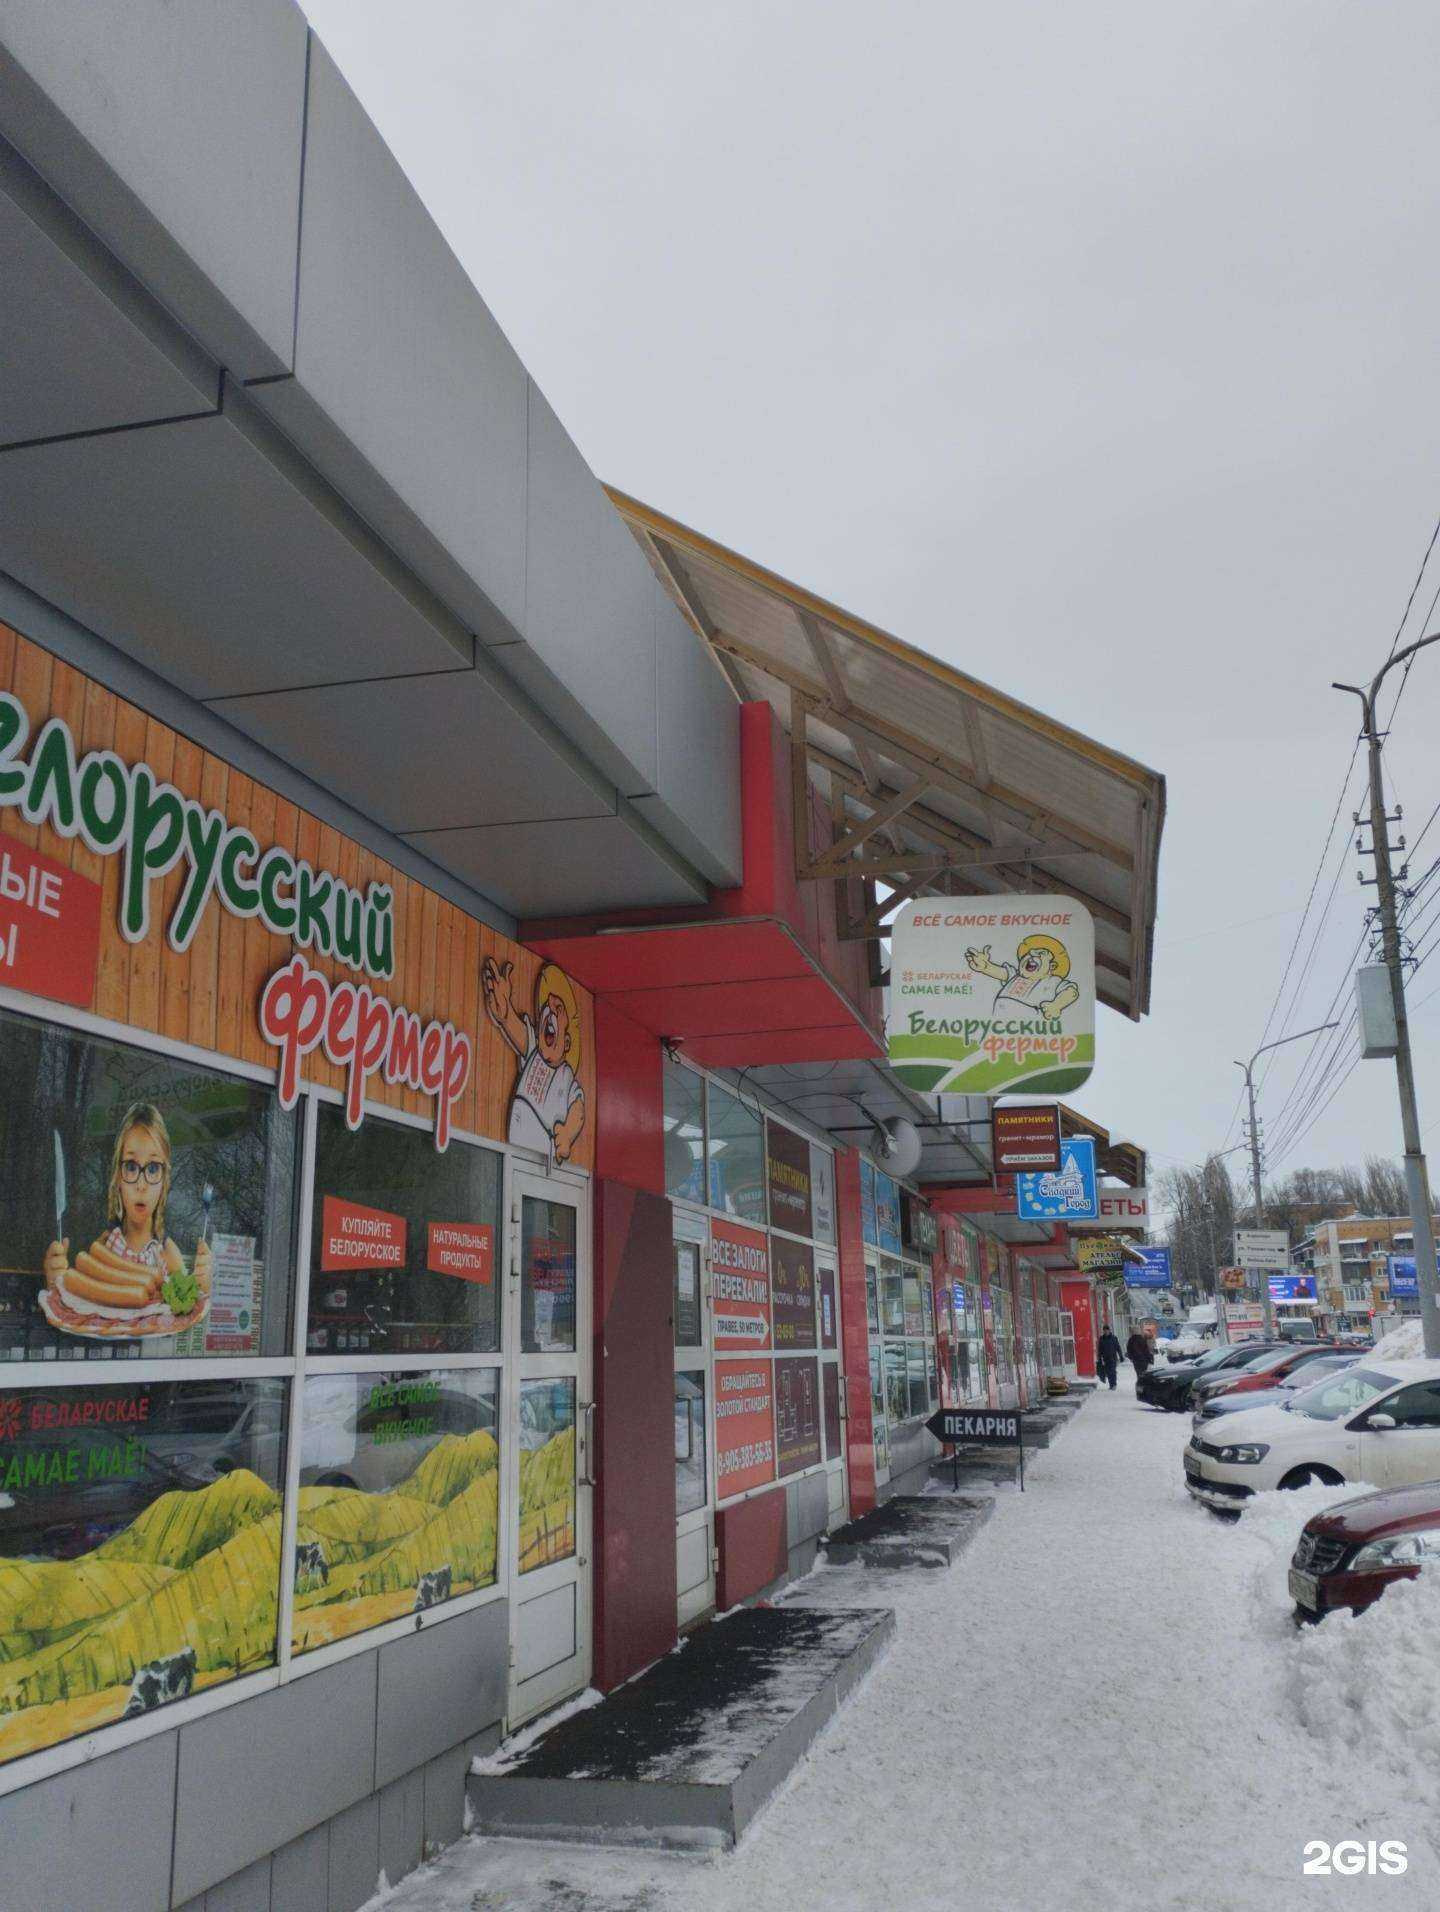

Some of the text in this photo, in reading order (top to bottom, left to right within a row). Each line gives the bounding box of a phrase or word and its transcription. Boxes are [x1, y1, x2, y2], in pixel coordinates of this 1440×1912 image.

[912, 913, 1073, 927] ВСЁ САМОЕ ВКУСНОЕ
[917, 972, 973, 981] БЕЛАРУСКАЕ
[901, 983, 973, 995] САМАЕ МАЁ!
[908, 1010, 1063, 1046] Белорусский
[260, 955, 470, 1153] фермер
[983, 1036, 1076, 1063] фермер
[998, 1115, 1054, 1125] ПАМЯТНИКИ
[1064, 1197, 1091, 1210] Город
[1100, 1198, 1146, 1216] ЕТЫ
[342, 1216, 392, 1239] КУПЛЯЙТЕ
[330, 1238, 401, 1262] БЕЛОРУССКОЕ
[433, 1229, 489, 1251] НАТУРАЛЬНЫЕ
[440, 1250, 482, 1269] ПРОДУКТЫ
[713, 1238, 767, 1274] ВСЕ ЗАЛОГИ
[713, 1273, 768, 1304] ПЕРЕЕХАЛИ!
[31, 1398, 149, 1430] БЕЛАРУСКАЕ
[944, 1416, 1017, 1437] ПЕКАРНЯ
